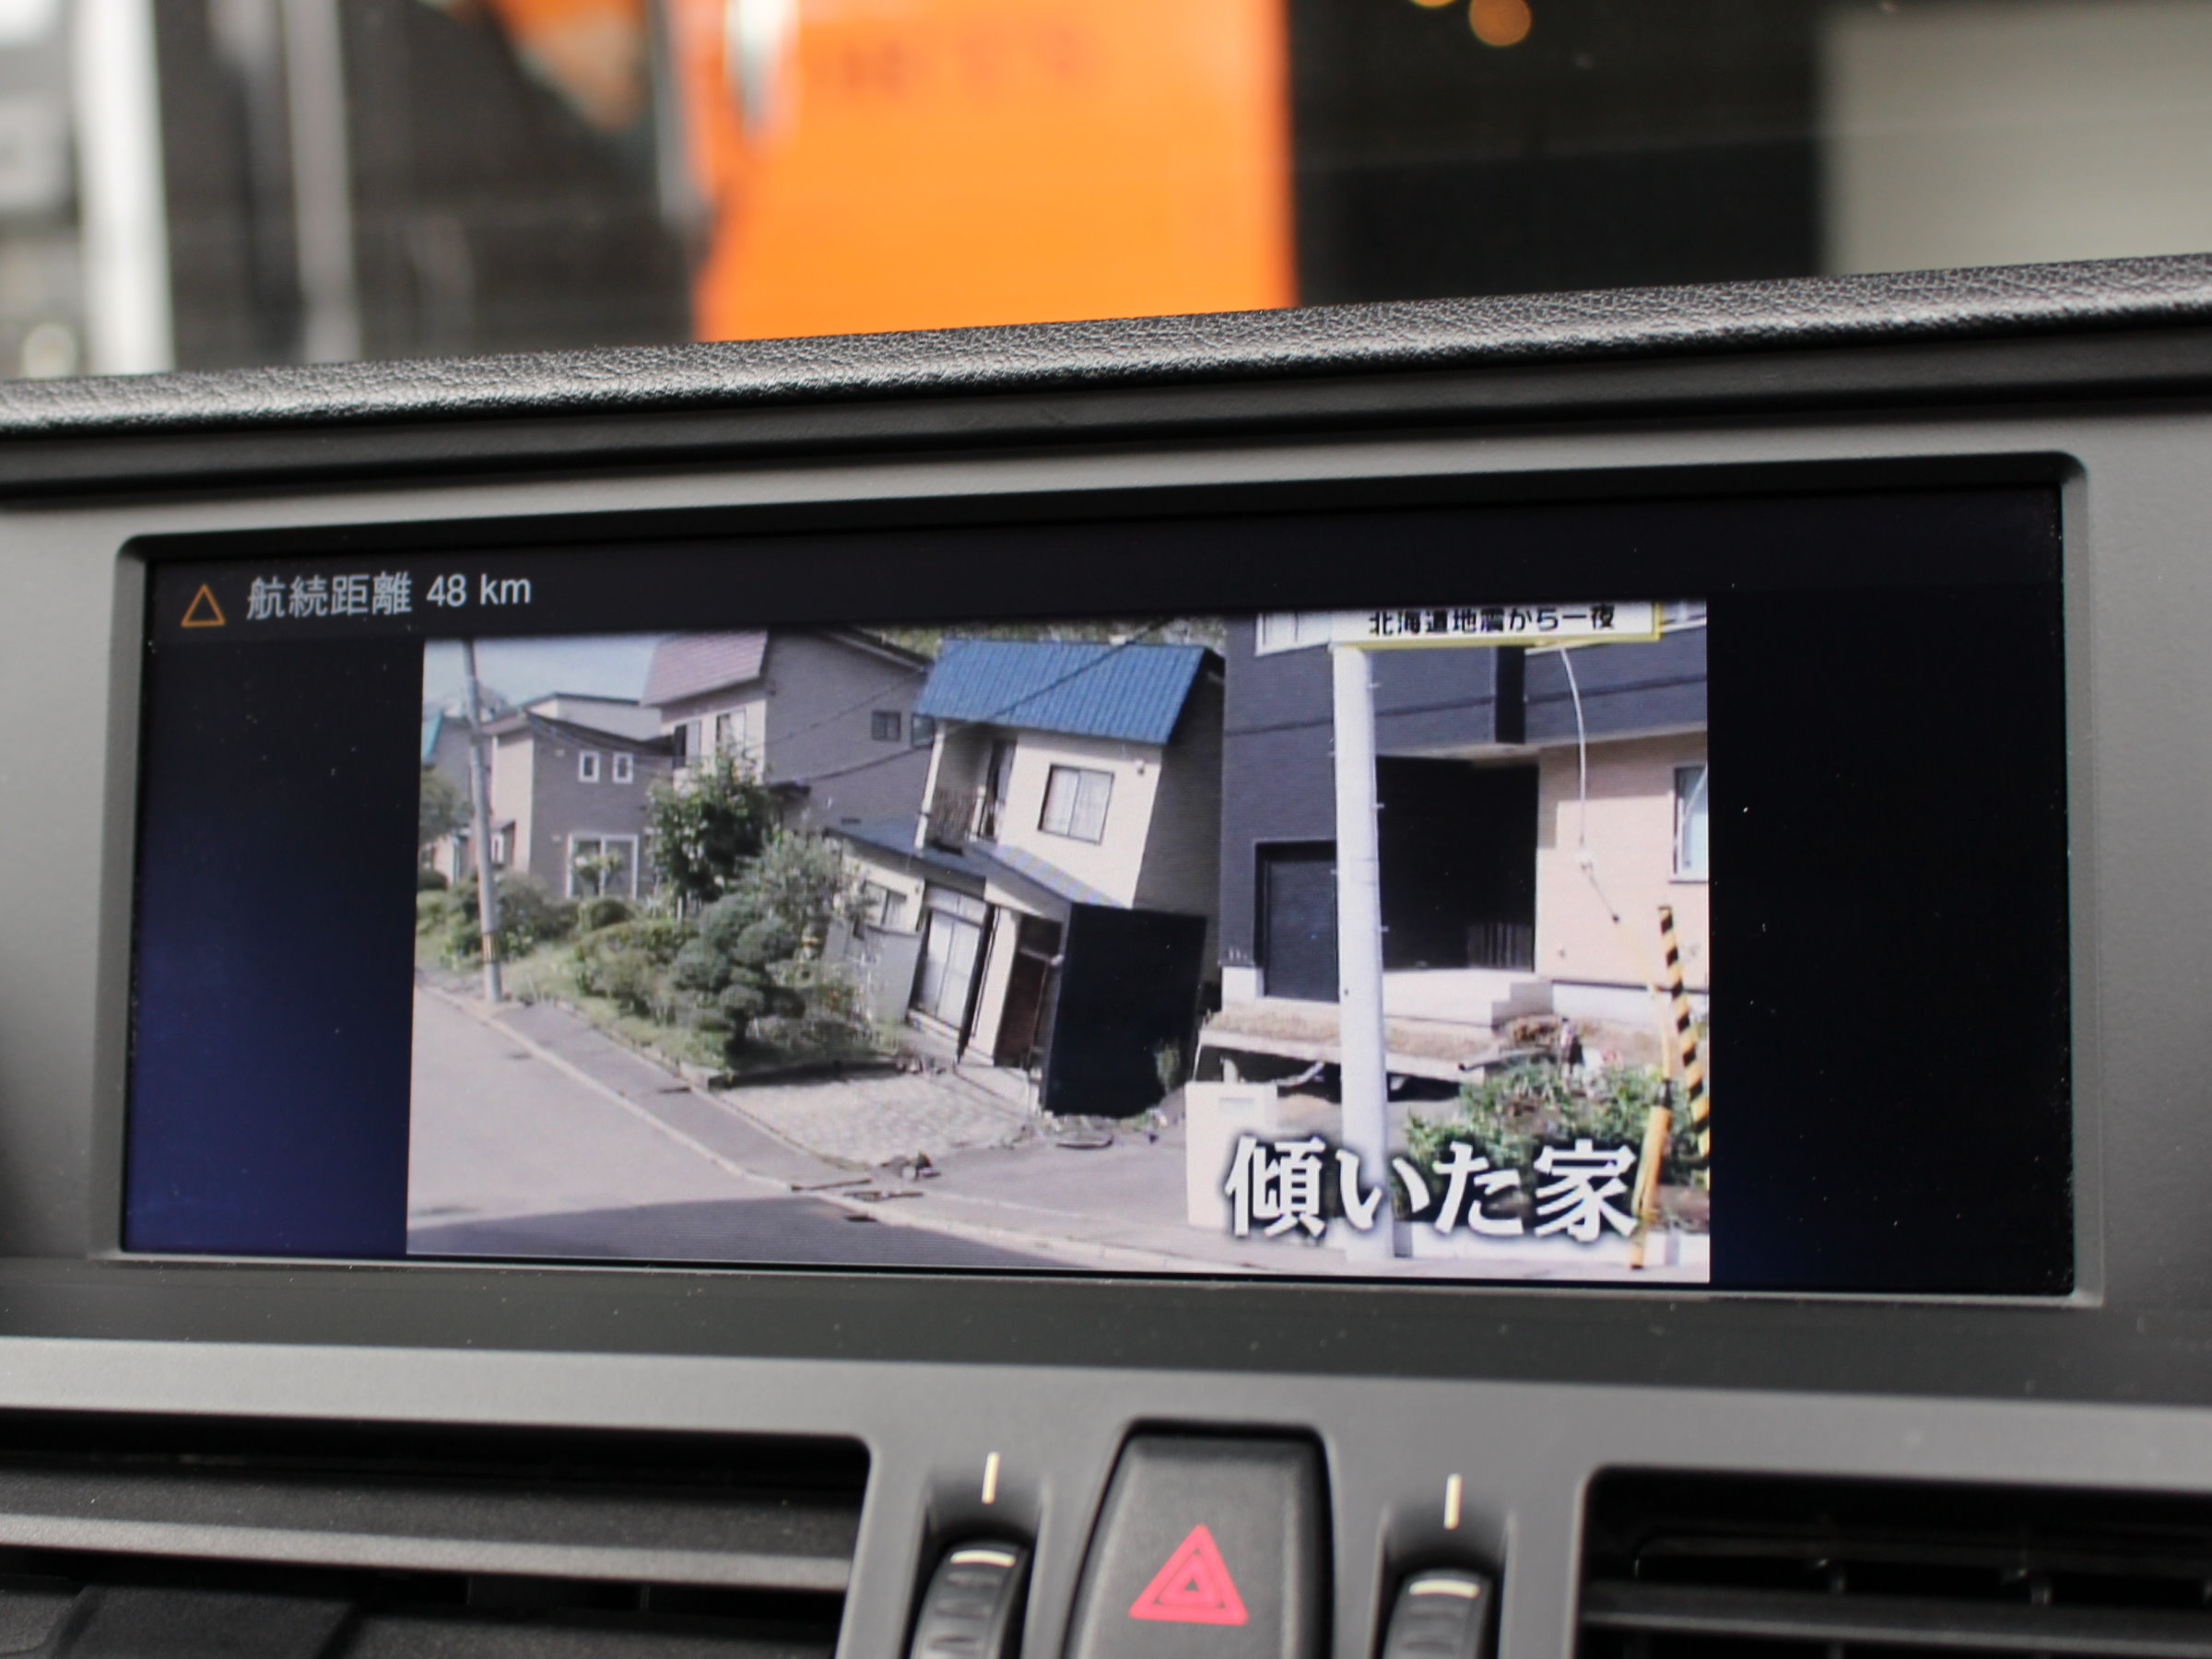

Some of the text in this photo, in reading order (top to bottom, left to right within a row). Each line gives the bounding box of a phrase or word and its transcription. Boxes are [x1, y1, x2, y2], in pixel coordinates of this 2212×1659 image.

[246, 571, 532, 620] 航続距離 48 km
[1224, 1135, 1638, 1241] 傾いた家
